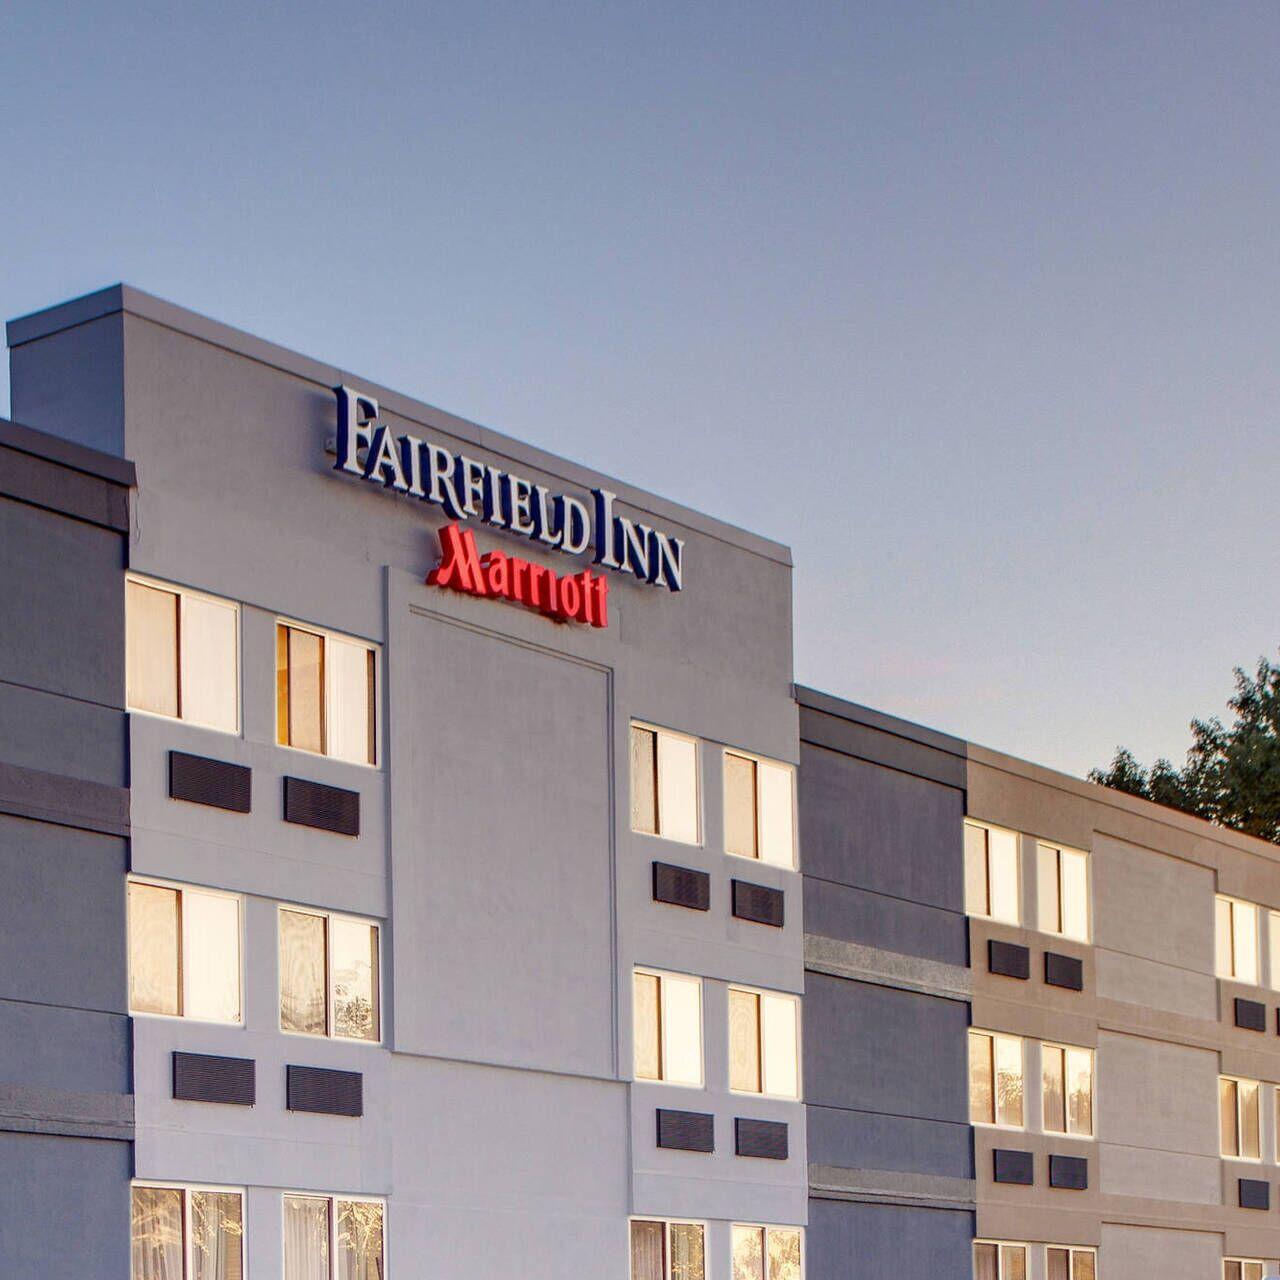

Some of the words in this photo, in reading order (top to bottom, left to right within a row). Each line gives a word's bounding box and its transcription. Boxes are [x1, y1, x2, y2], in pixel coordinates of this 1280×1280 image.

[333, 384, 591, 556] FAIRFIELD
[591, 488, 685, 592] INN
[426, 521, 610, 628] Marriott
